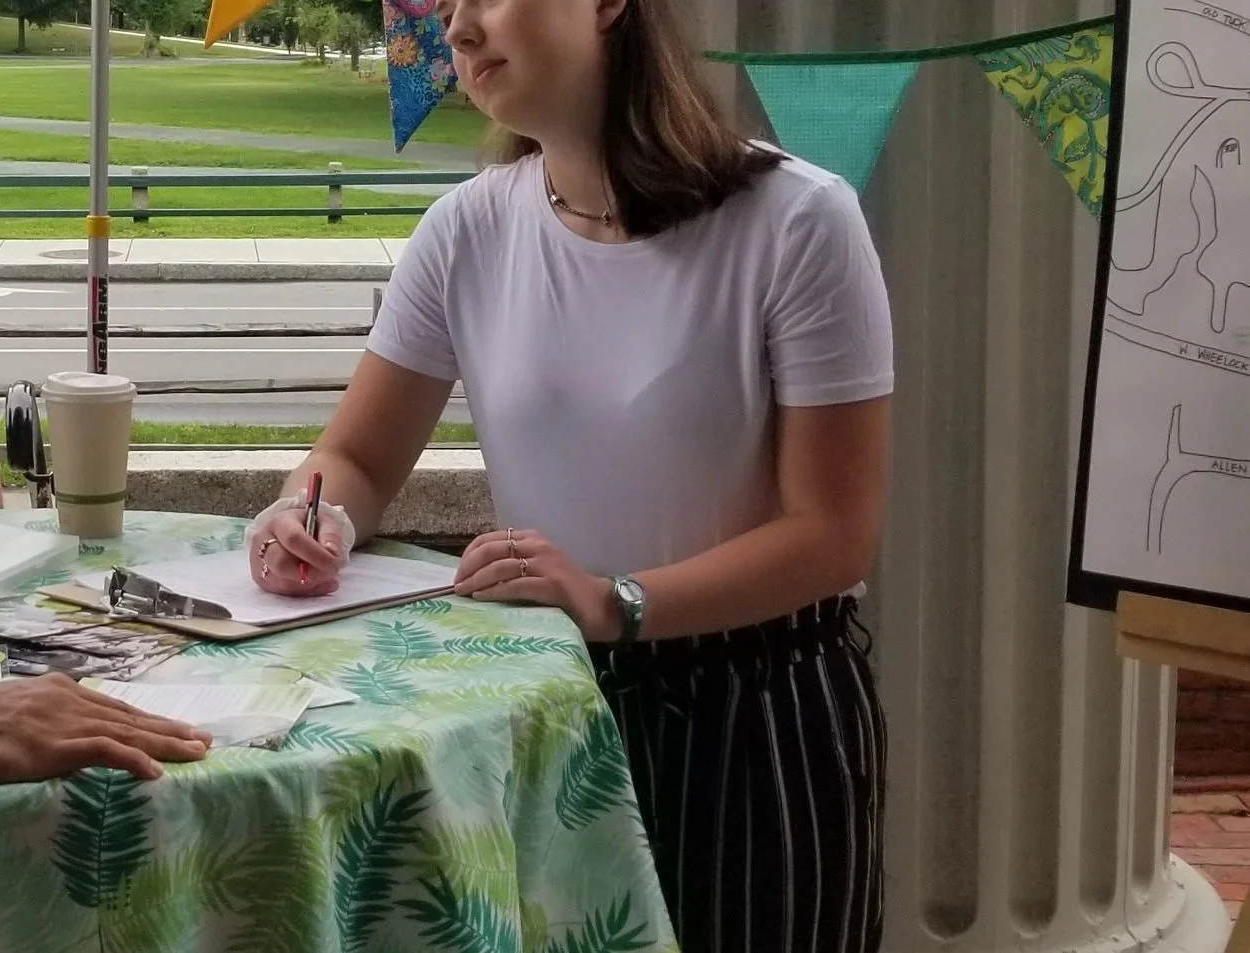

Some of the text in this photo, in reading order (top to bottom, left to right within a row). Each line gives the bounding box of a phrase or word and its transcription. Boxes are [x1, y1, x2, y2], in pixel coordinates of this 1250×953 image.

[1202, 8, 1219, 18] OLD
[1197, 348, 1249, 370] WHEELOCK
[1211, 459, 1247, 473] ALLEN
